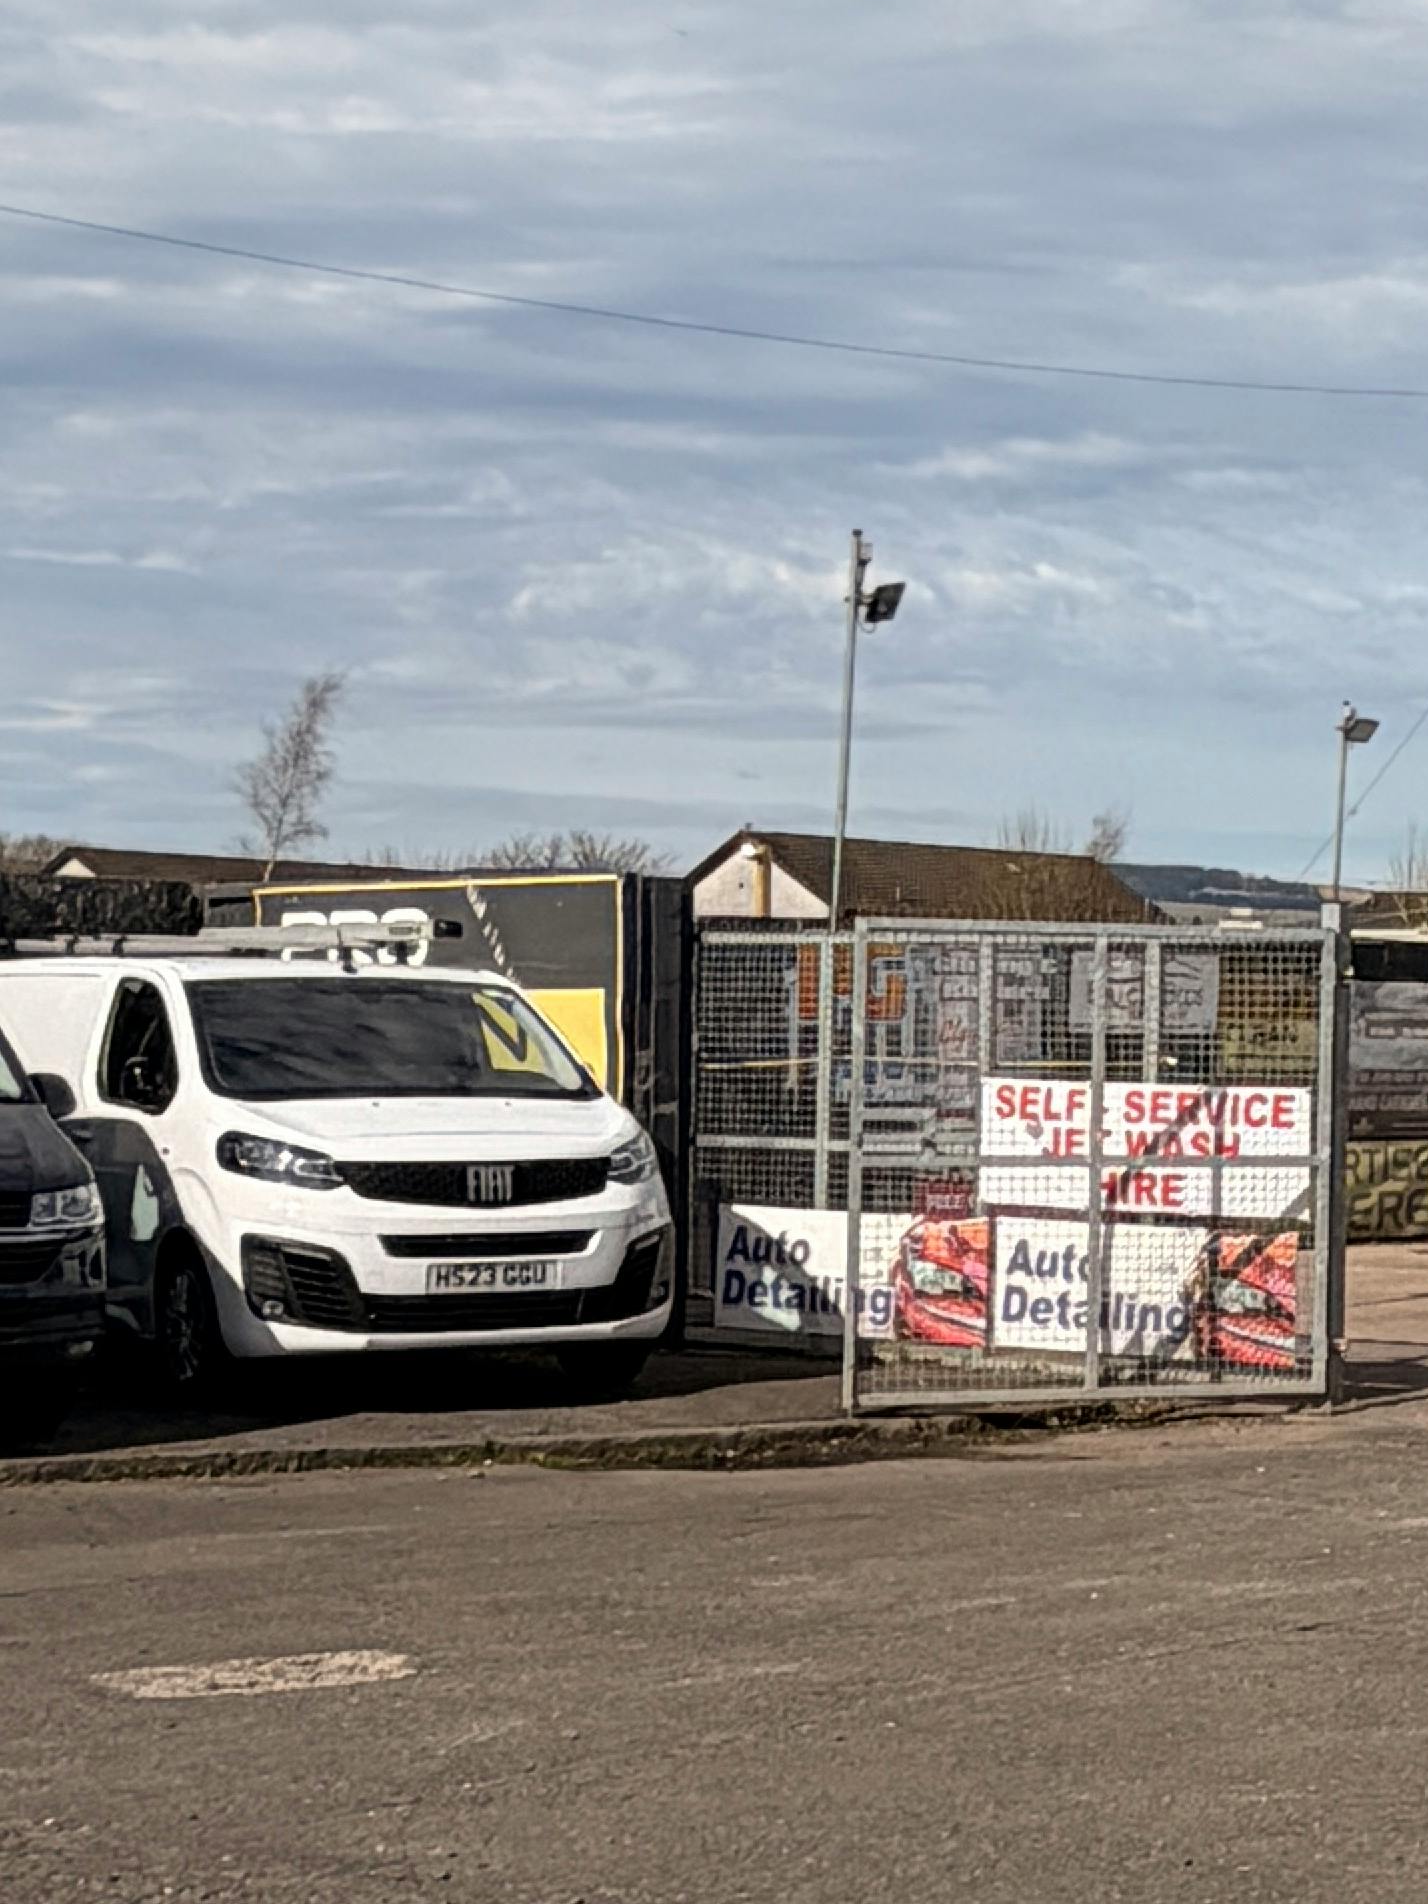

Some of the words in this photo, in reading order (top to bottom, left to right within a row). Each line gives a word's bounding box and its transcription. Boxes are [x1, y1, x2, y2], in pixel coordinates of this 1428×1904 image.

[995, 1085, 1086, 1122] SELF
[1124, 1090, 1297, 1129] SERVICE
[1125, 1130, 1241, 1159] WASH
[467, 1165, 514, 1201] FIAT
[727, 1224, 811, 1265] Auto
[722, 1269, 892, 1326] Detailing
